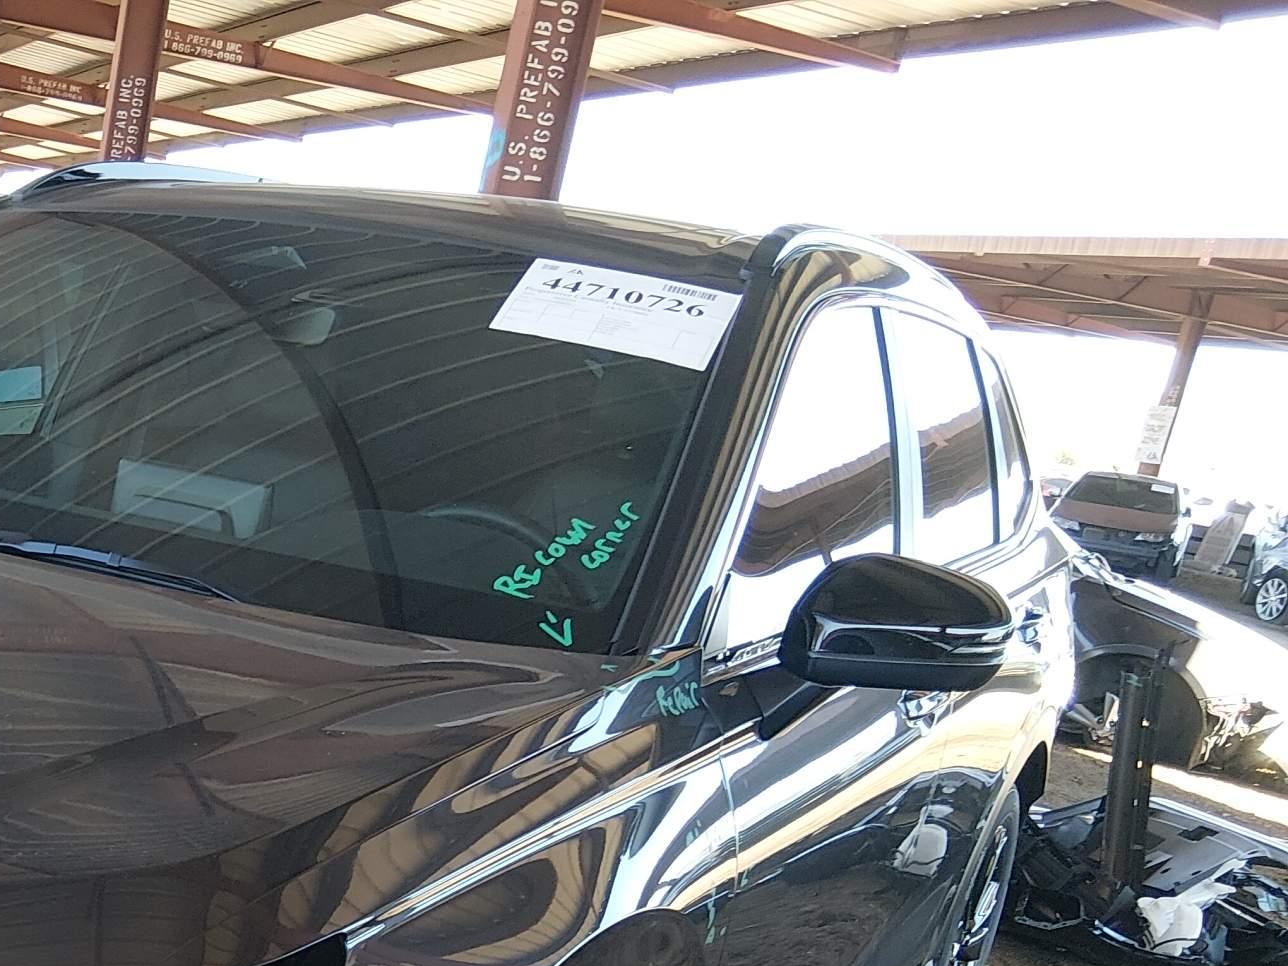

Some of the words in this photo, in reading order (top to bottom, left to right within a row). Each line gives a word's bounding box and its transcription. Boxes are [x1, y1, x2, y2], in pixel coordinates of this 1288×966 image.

[186, 33, 224, 50] PREFAB
[515, 20, 554, 120] PREFAB
[110, 109, 129, 161] REFAB
[541, 276, 706, 319] 44710726
